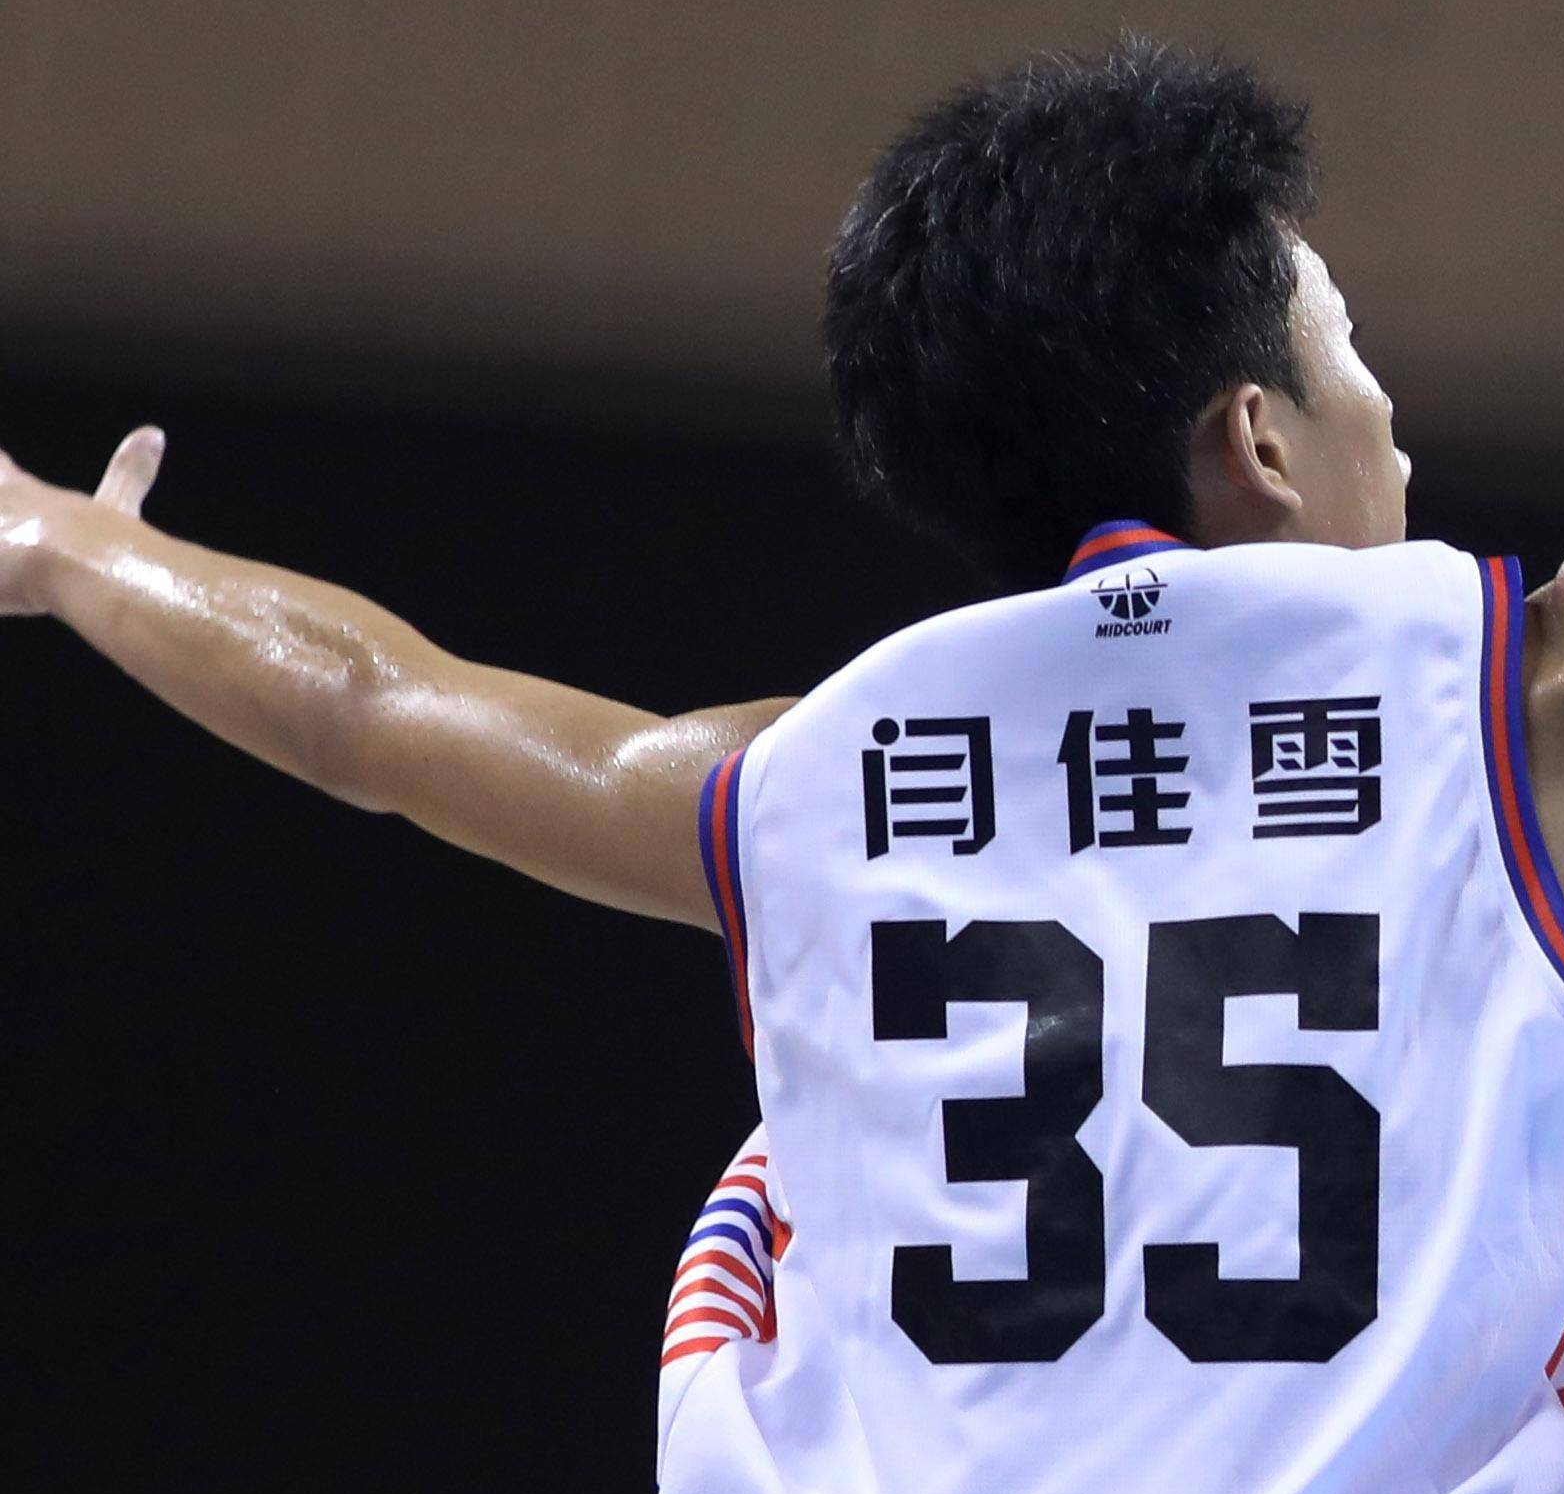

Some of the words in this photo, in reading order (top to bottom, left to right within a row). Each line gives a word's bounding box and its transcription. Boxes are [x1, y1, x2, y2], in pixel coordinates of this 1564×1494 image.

[1095, 618, 1172, 638] MIDCOURT
[862, 695, 1382, 860] 闫佳雪
[870, 912, 1381, 1364] 35
